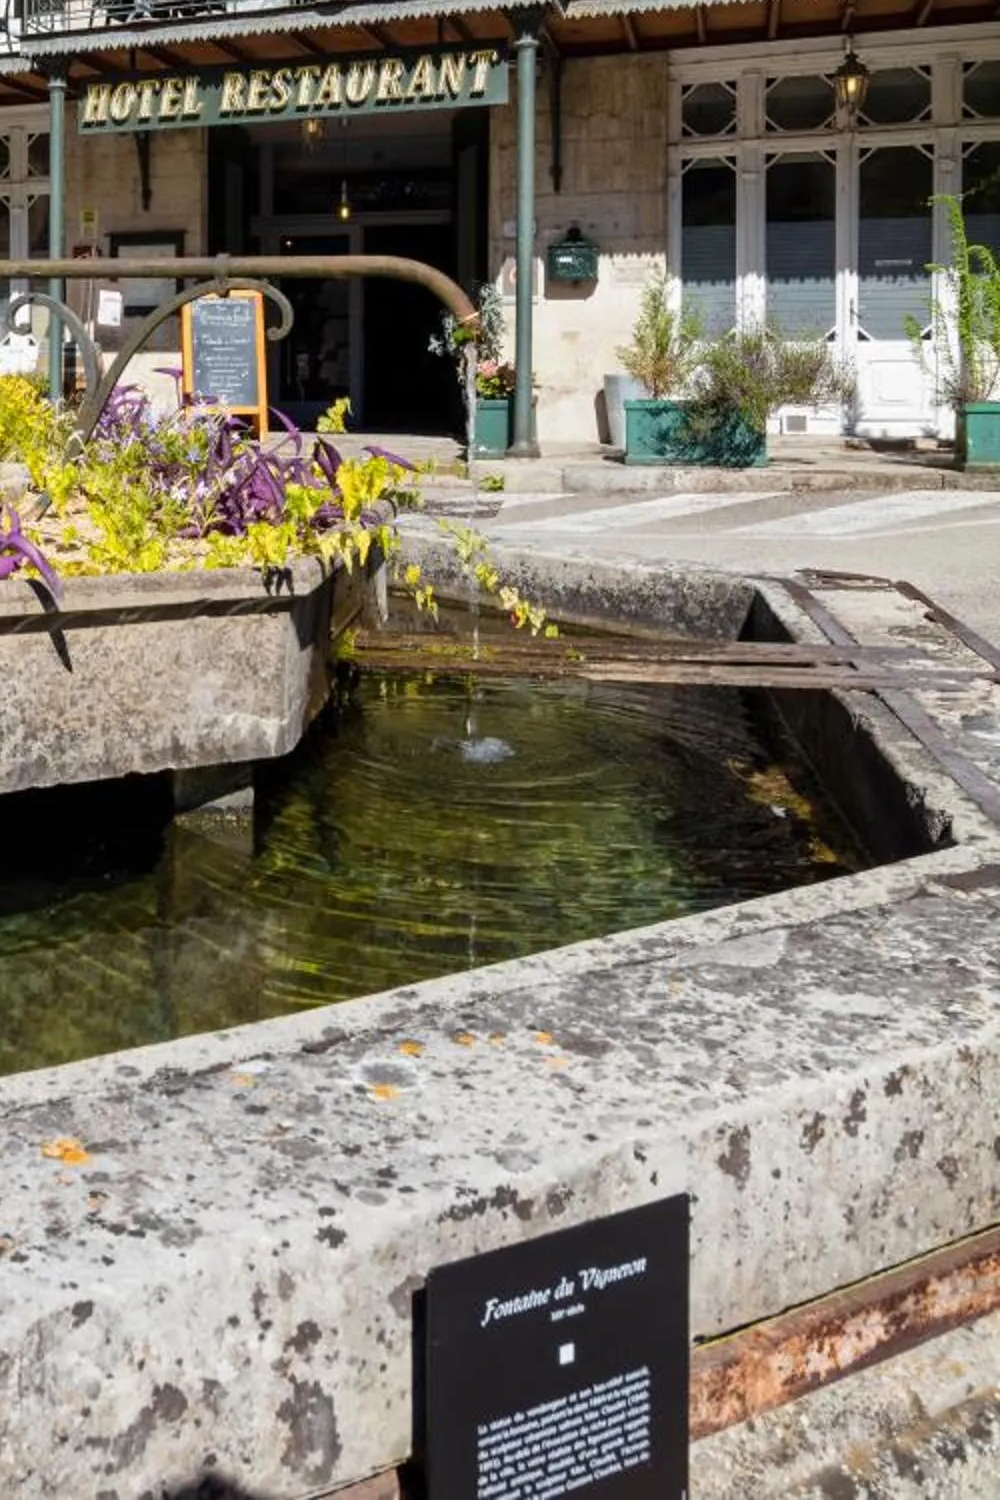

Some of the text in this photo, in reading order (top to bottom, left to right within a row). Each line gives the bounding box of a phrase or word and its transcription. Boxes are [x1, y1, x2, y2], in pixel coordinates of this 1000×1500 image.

[81, 49, 498, 128] HOTEL RESTAURANT
[480, 1287, 551, 1328] Fontaine
[554, 1276, 575, 1301] du
[578, 1257, 648, 1291] Vigneron
